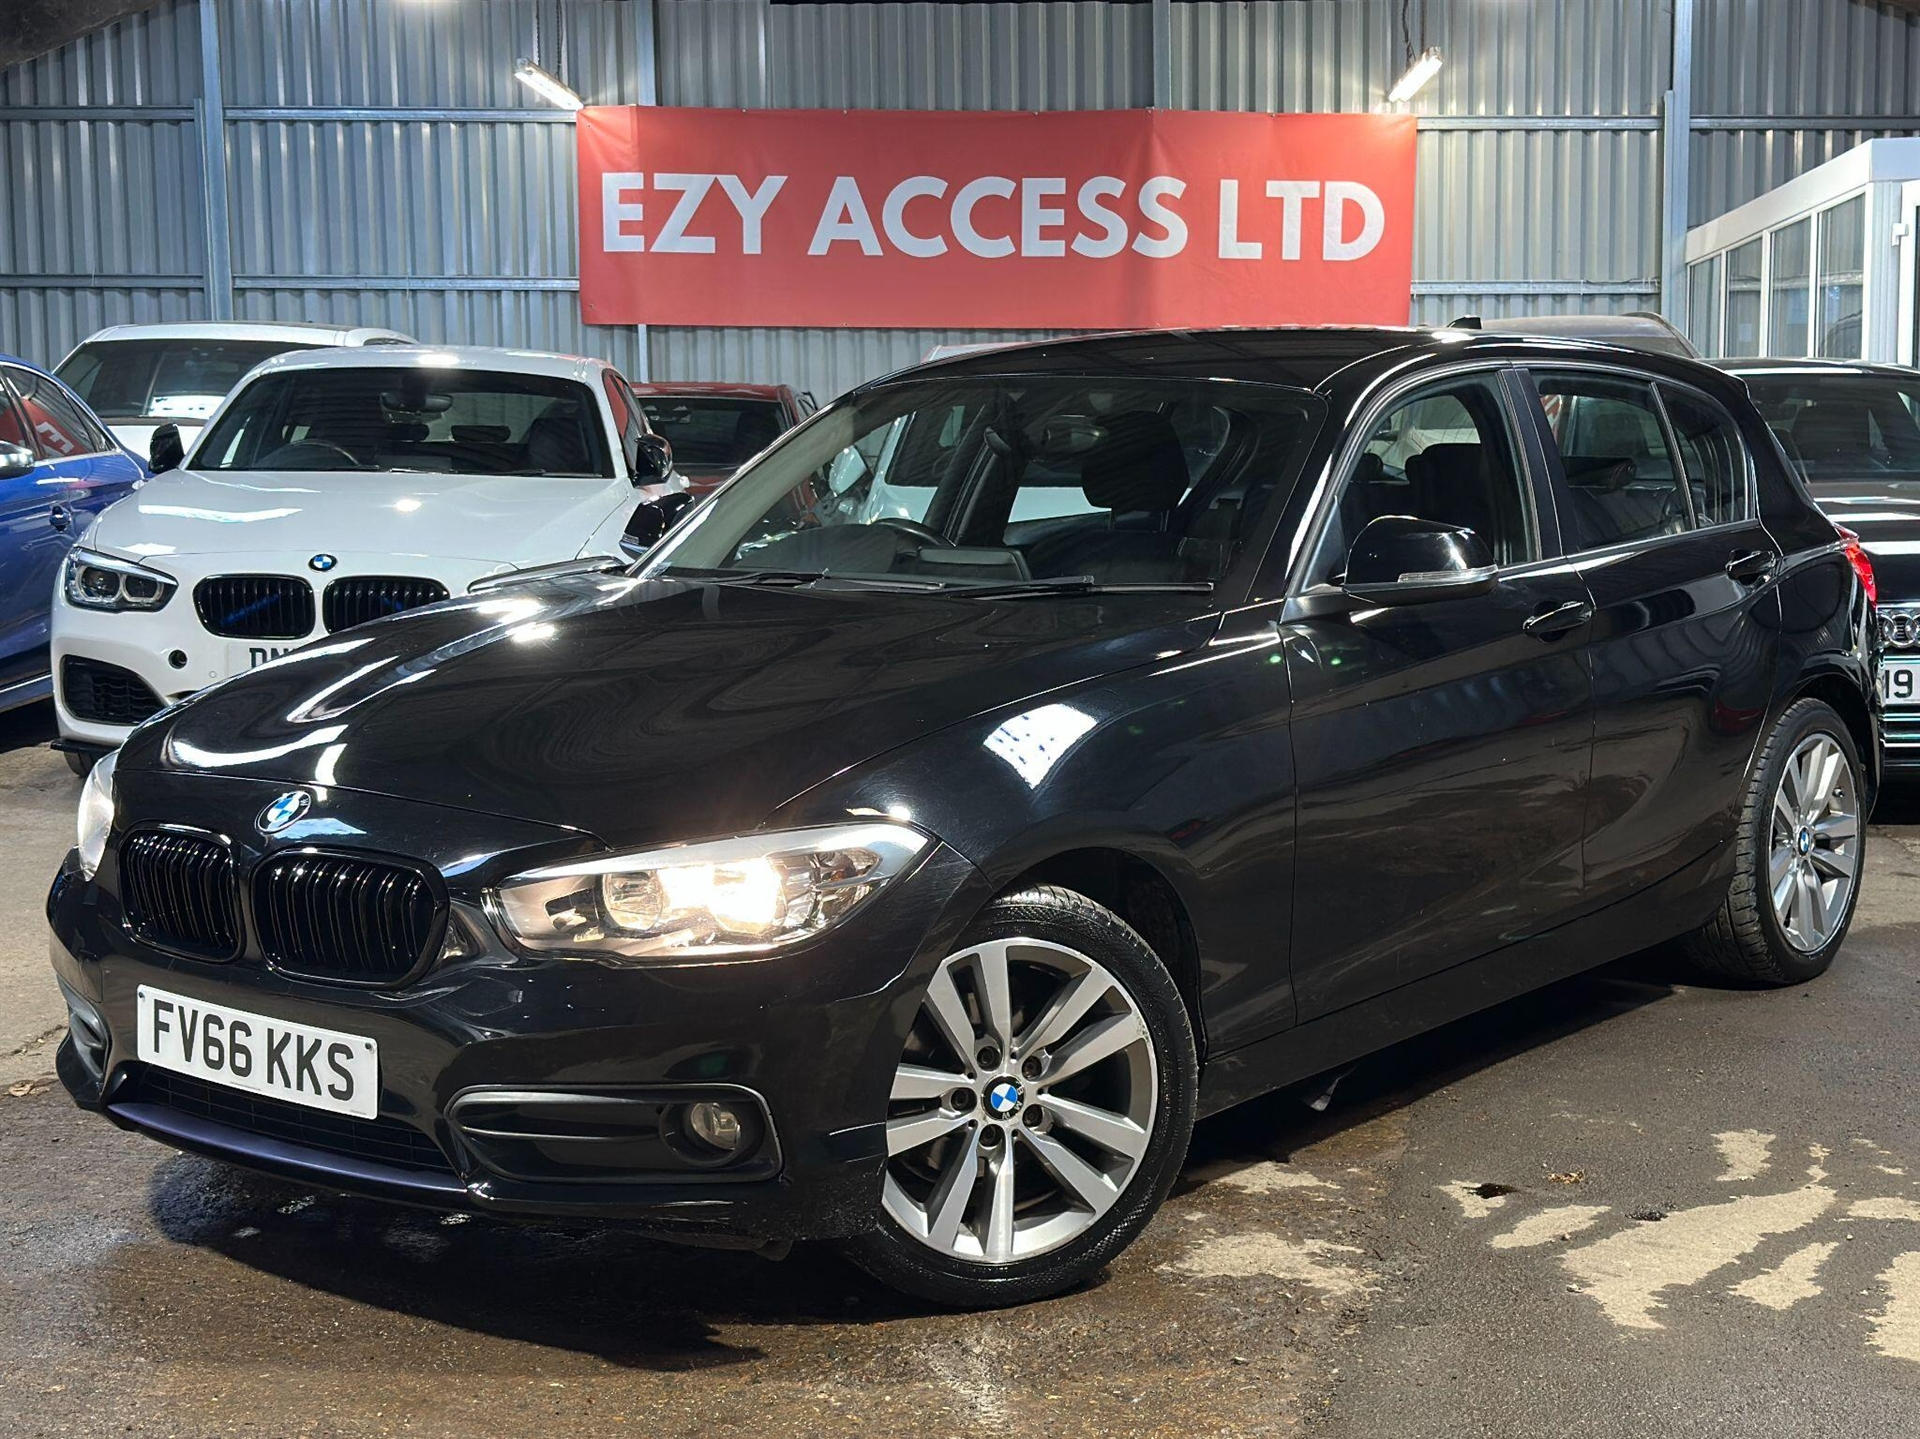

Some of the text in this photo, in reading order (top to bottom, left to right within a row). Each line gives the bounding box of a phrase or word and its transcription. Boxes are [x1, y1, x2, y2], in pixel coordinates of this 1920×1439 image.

[601, 173, 1385, 261] EZY ACCESS LTD
[154, 999, 354, 1102] FV66 KKS
